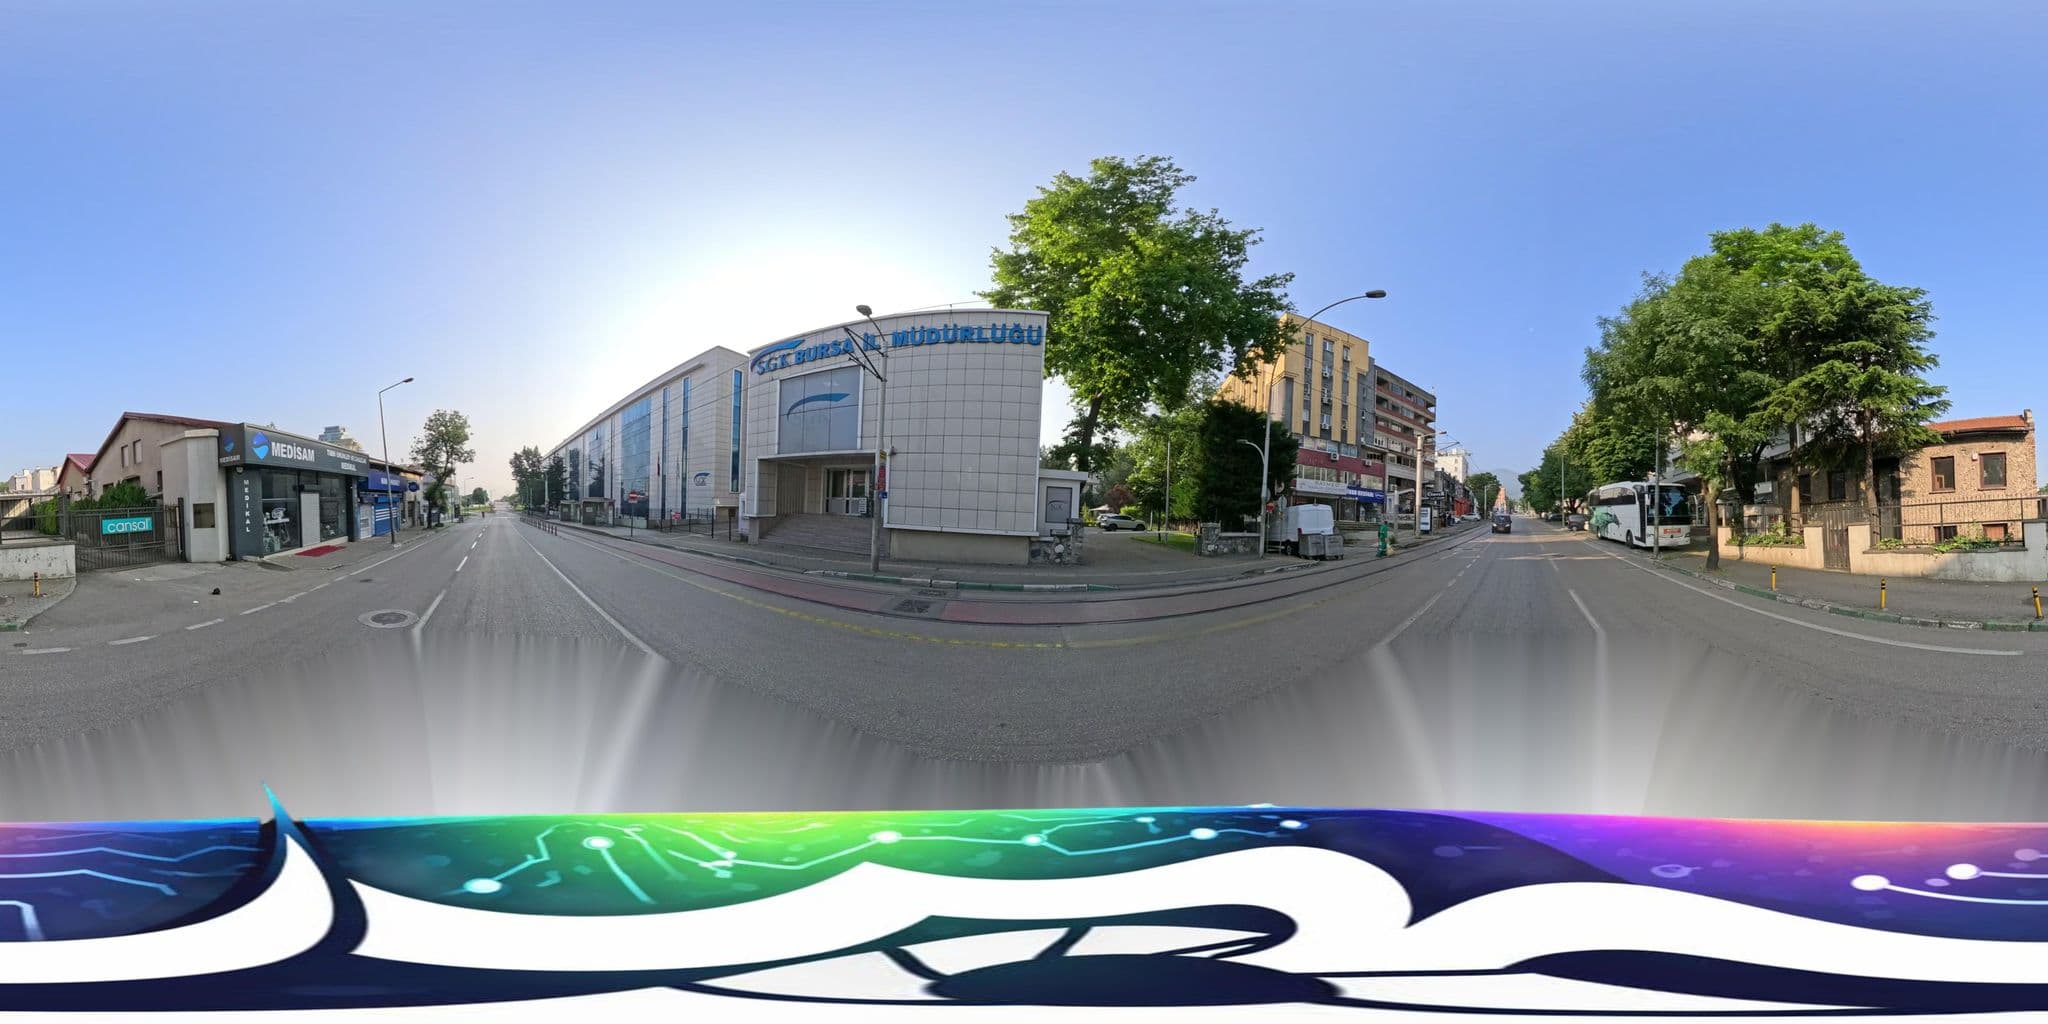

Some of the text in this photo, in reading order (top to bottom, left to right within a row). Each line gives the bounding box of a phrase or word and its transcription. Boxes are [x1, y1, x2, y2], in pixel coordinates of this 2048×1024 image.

[795, 337, 855, 365] BURSA
[863, 331, 882, 352] İL
[891, 322, 1042, 347] MÜDÜRLÜĞÜ
[271, 441, 315, 462] MEDİSAM
[106, 518, 149, 533] cansal
